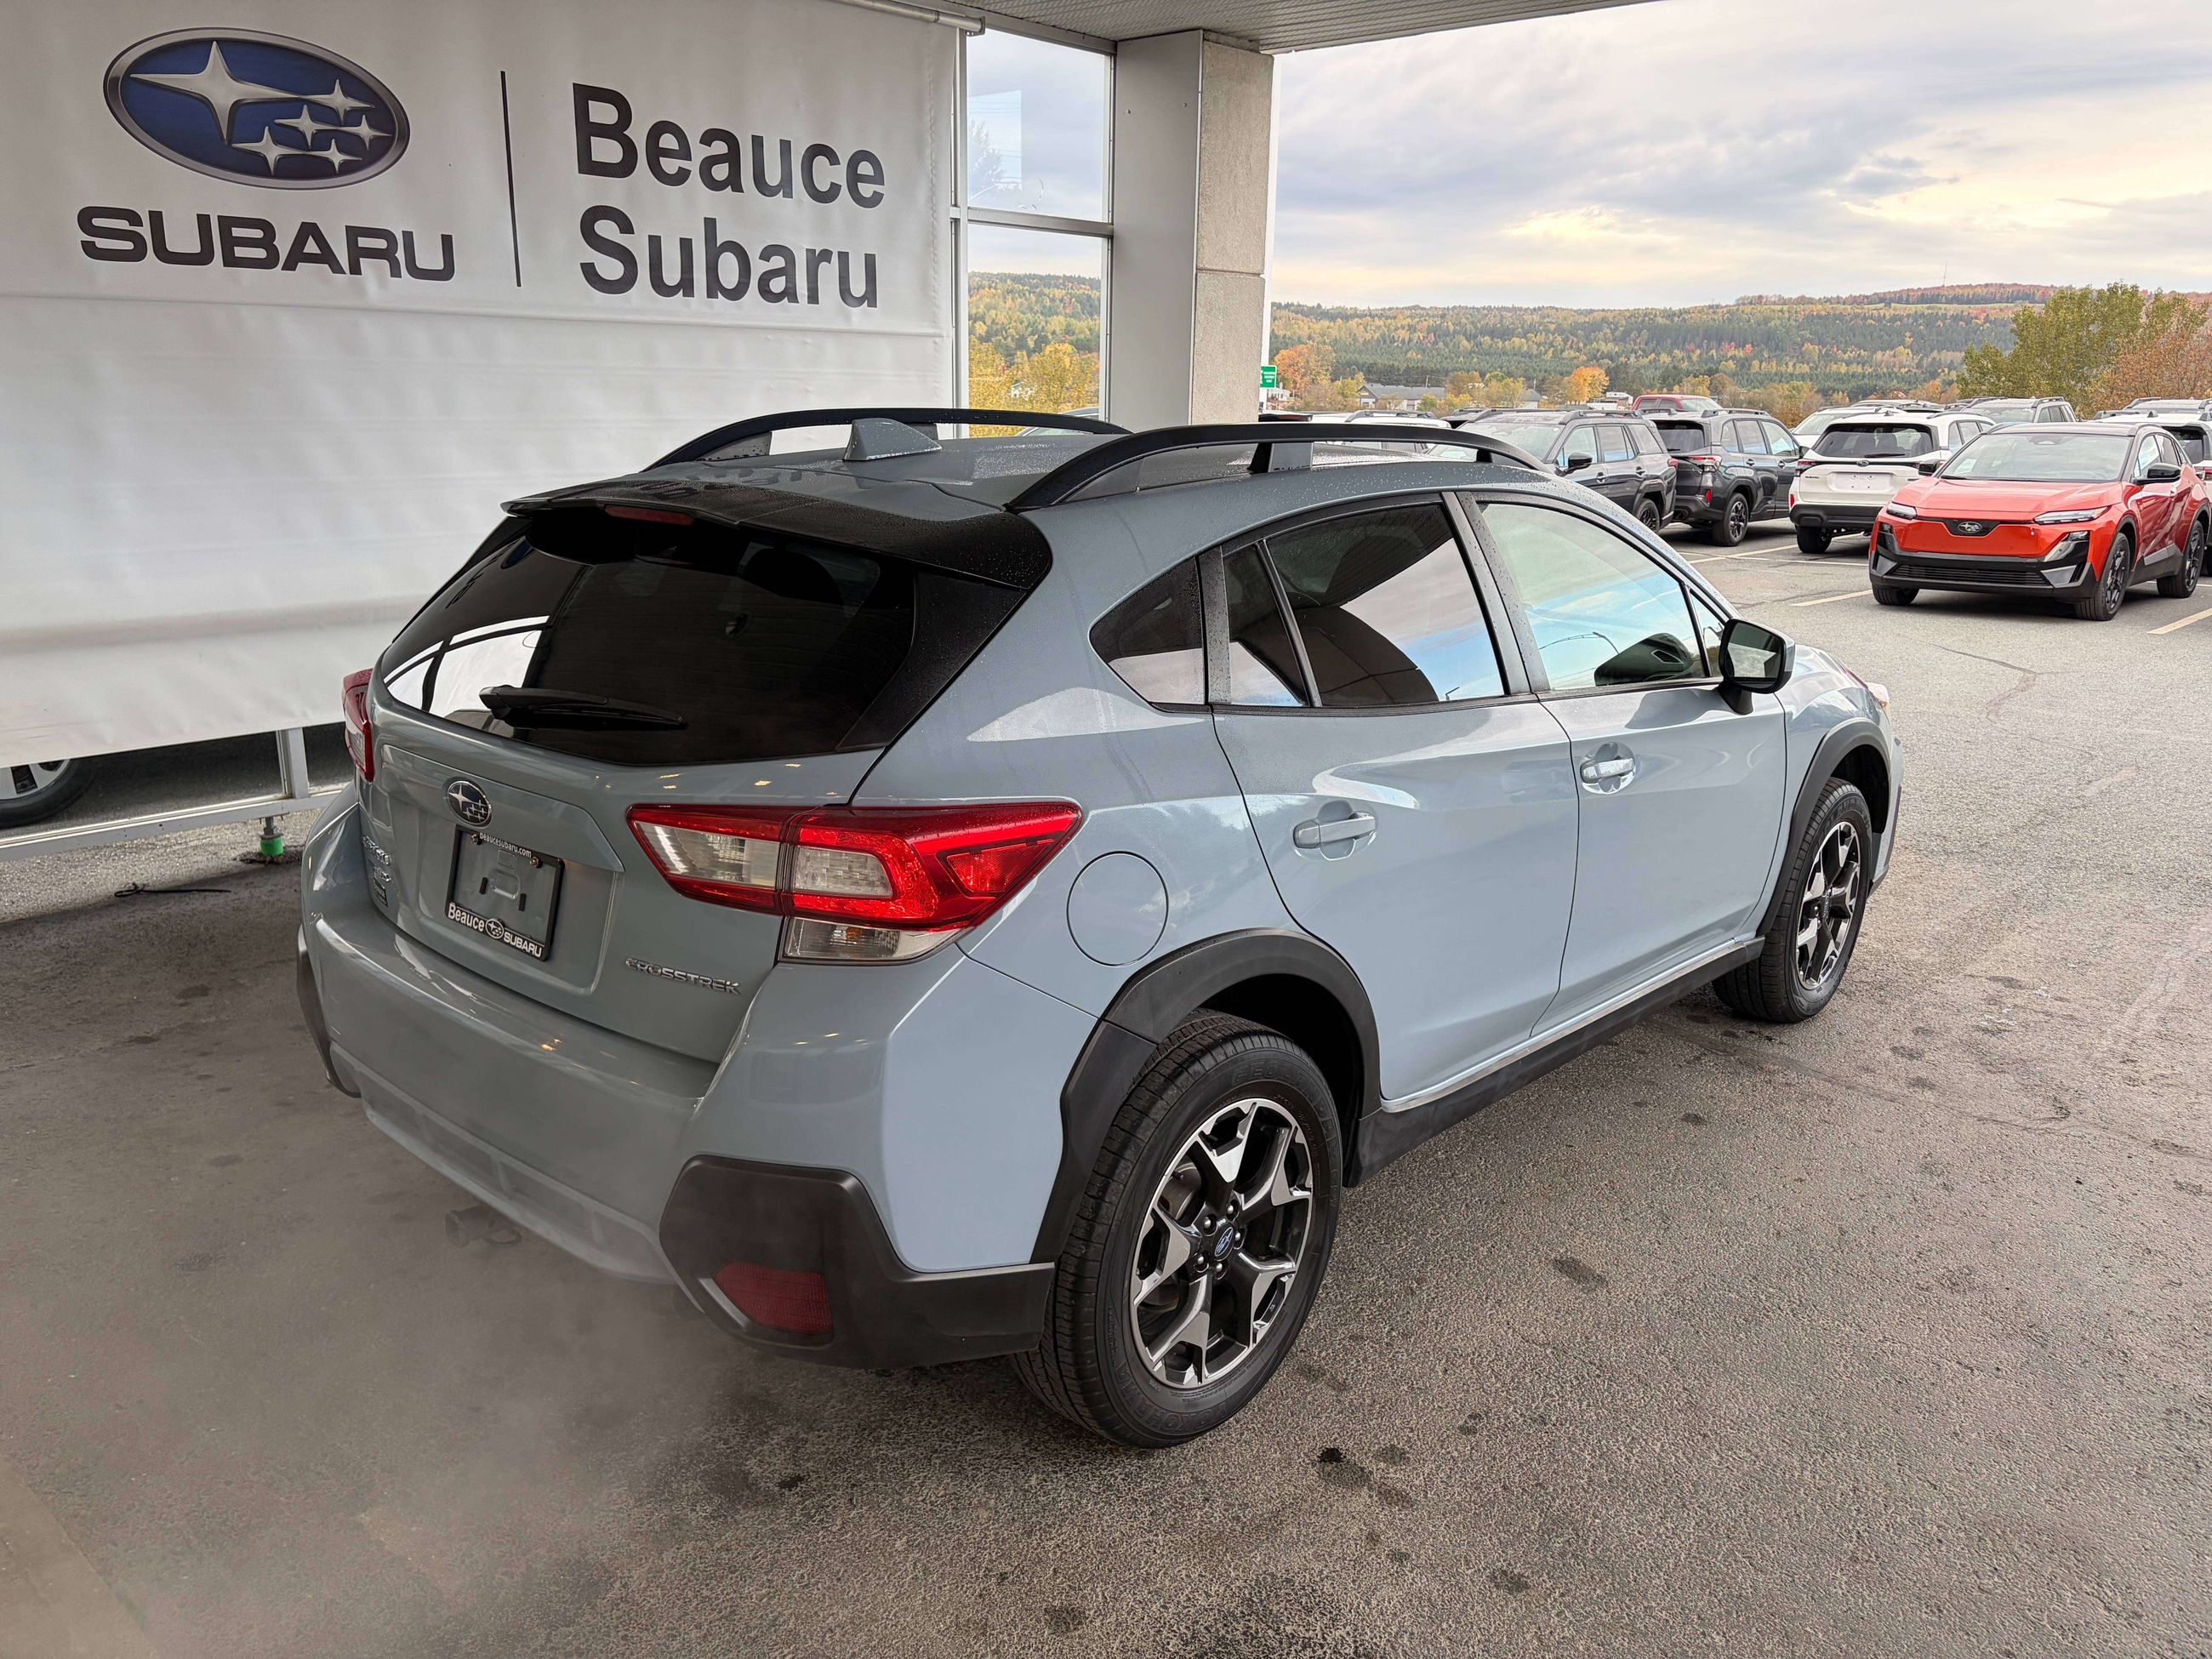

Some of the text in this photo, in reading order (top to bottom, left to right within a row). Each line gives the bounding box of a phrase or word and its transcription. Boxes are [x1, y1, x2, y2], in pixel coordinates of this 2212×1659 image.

[572, 82, 886, 208] Beauce
[77, 206, 455, 282] SUBARU
[579, 204, 878, 308] Subaru
[479, 832, 532, 858] beaucesubaru.com
[448, 903, 542, 958] Beauce SUBARU
[625, 957, 741, 995] CROSSTREK
